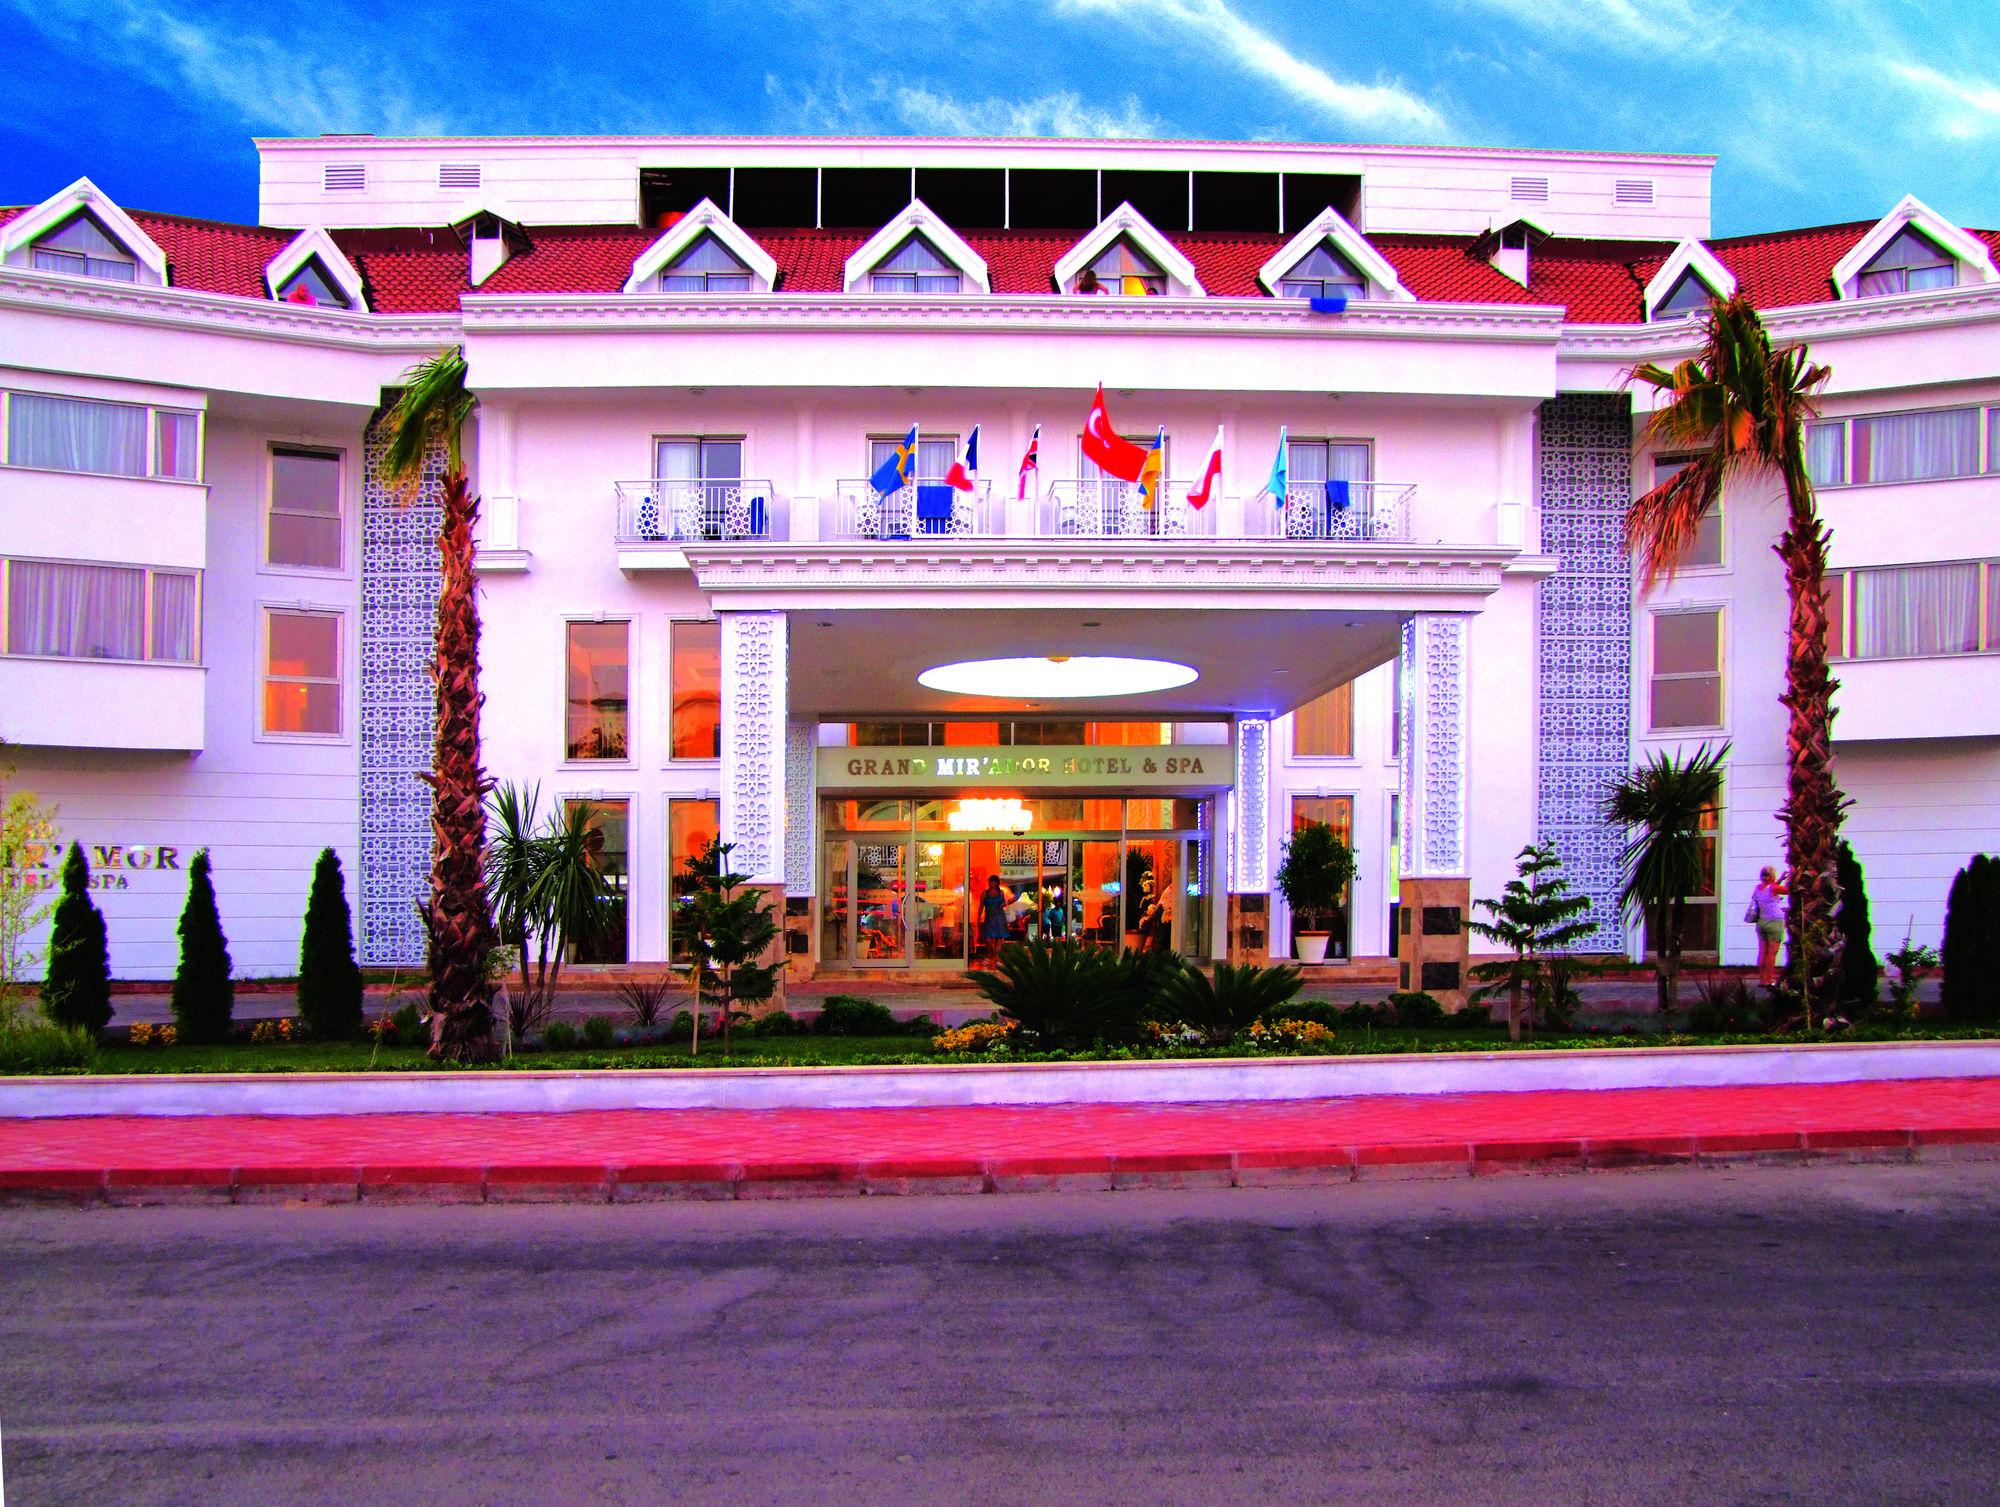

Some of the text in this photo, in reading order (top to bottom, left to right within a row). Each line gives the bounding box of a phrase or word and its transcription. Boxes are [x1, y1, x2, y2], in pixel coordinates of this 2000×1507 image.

[847, 758, 927, 776] GRAND
[1062, 756, 1132, 775] HOTEL
[1142, 757, 1158, 774] &
[1166, 757, 1204, 774] SPA
[88, 873, 130, 889] SPA
